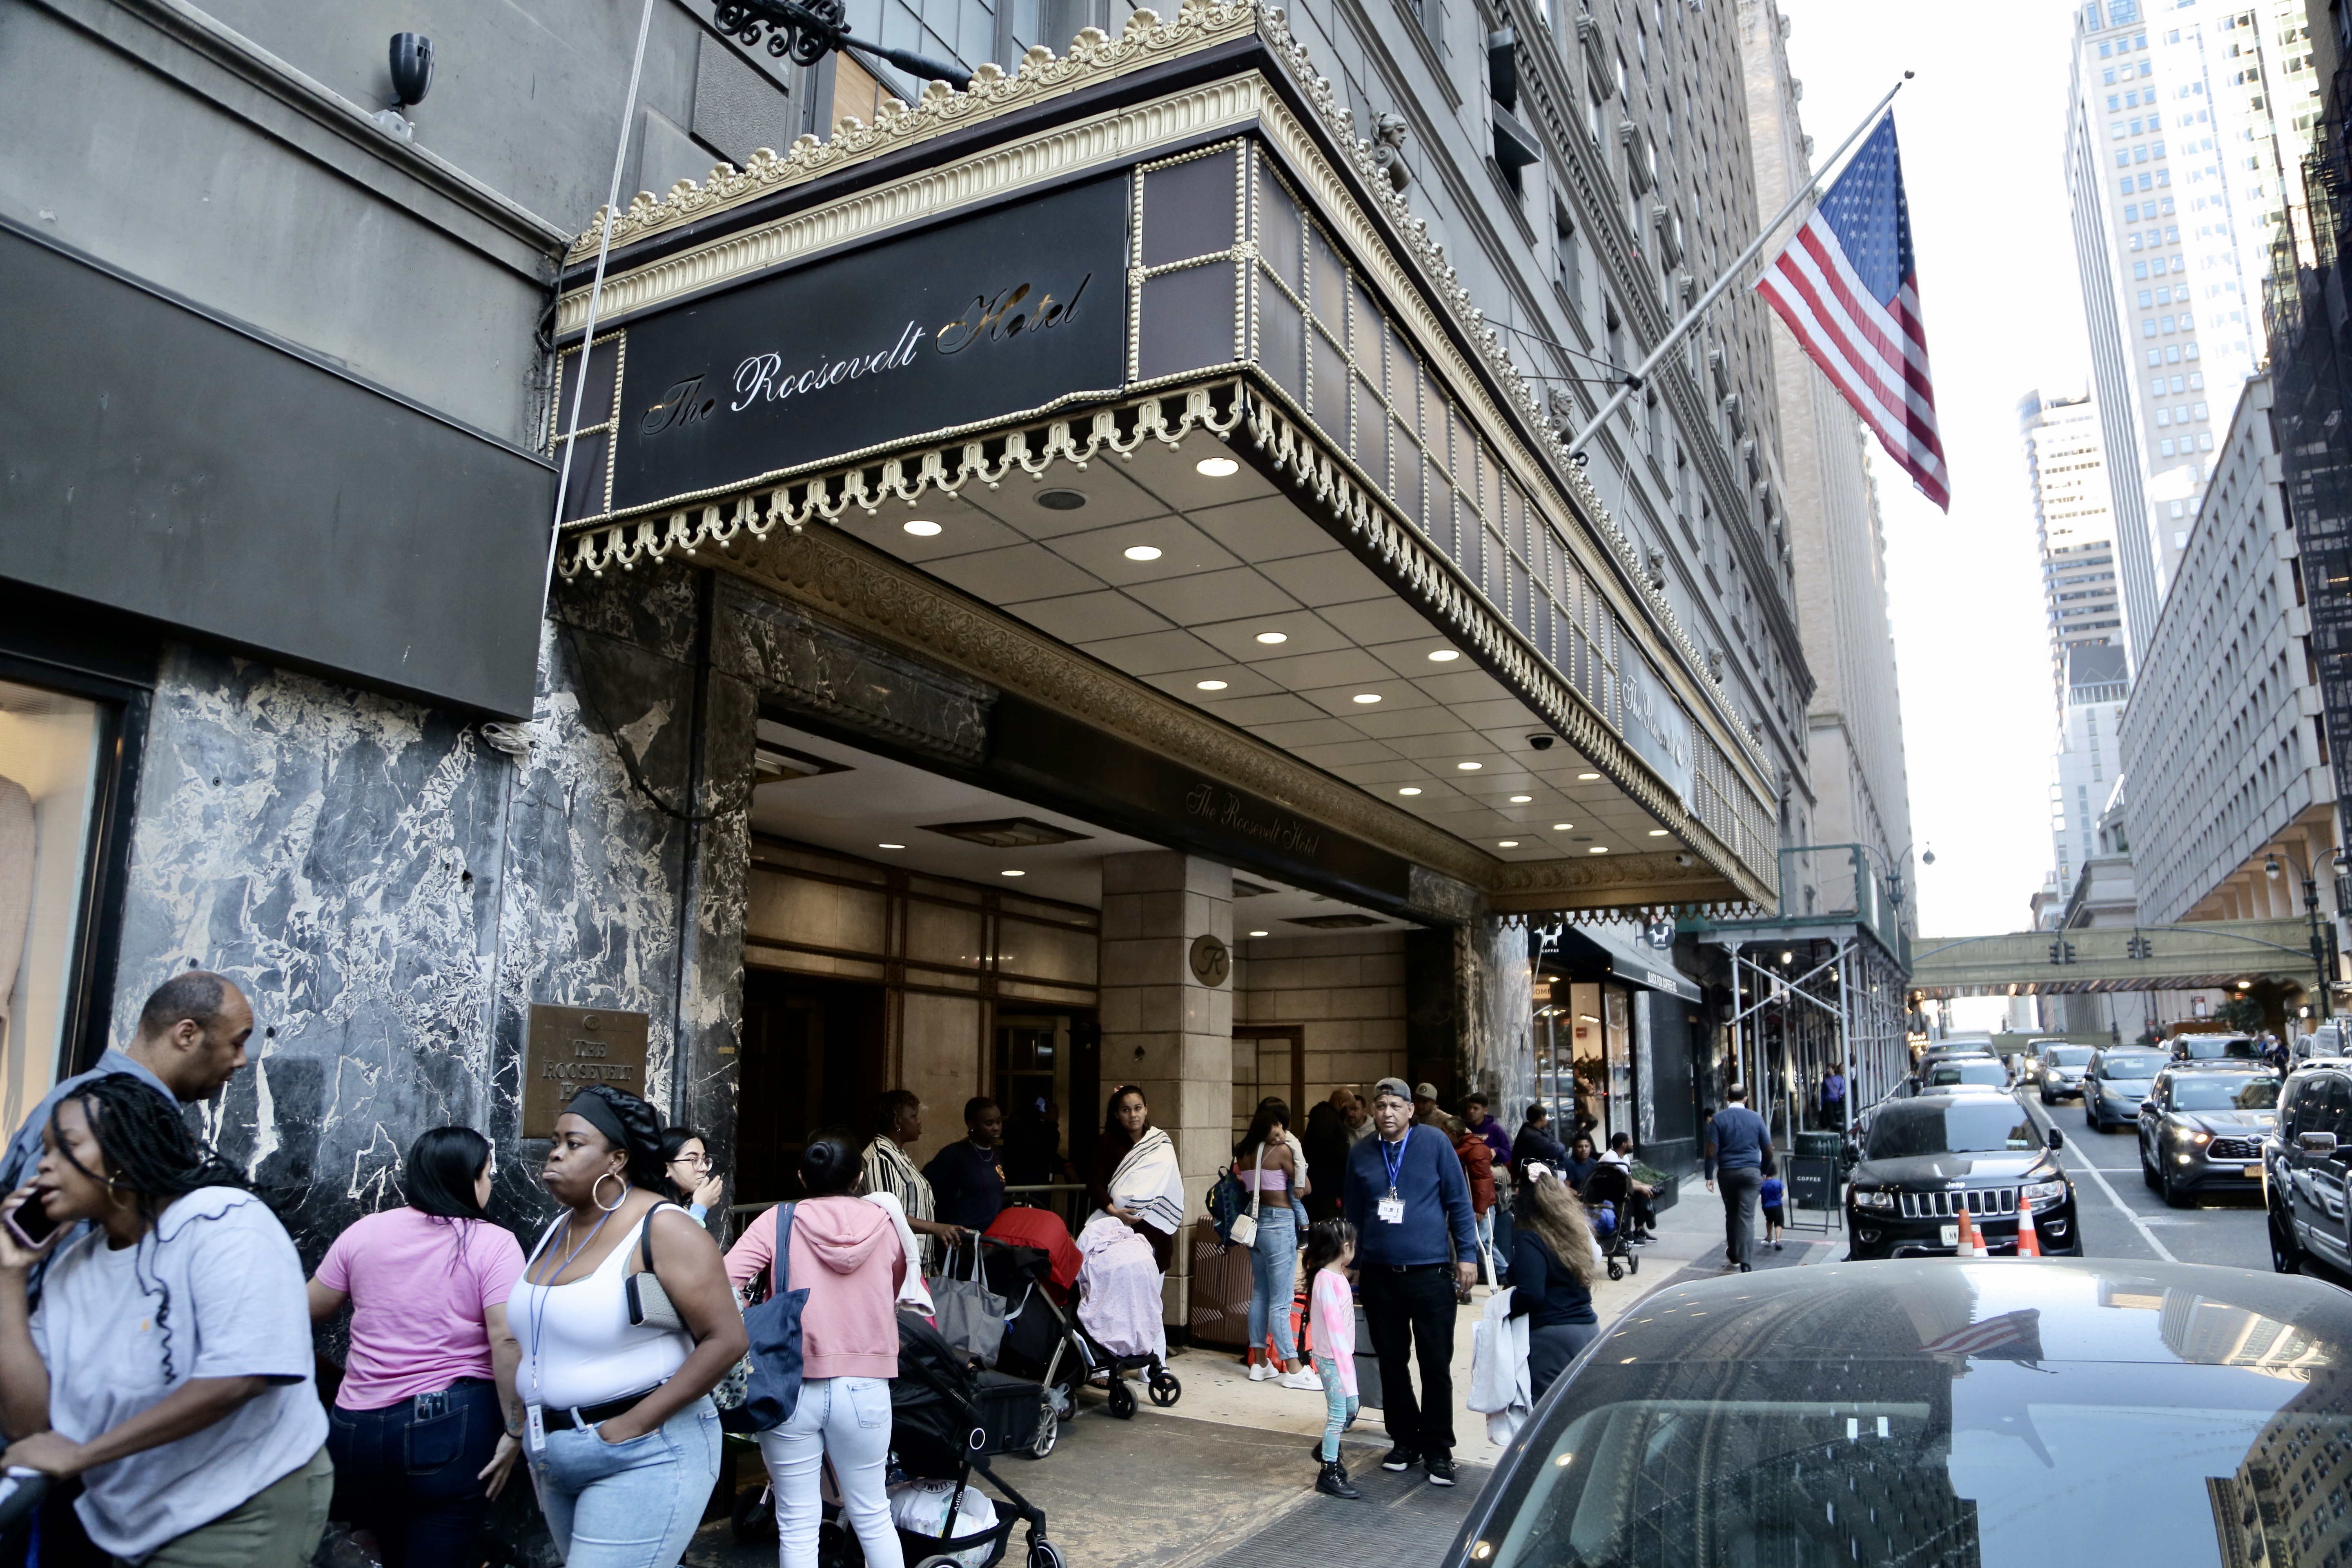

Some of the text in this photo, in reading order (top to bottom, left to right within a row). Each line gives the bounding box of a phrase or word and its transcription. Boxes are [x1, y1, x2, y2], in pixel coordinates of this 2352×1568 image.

[641, 272, 1092, 435] The Roosevelt Hotel
[1623, 674, 1642, 722] The
[1186, 783, 1319, 858] The Roosevelt Hotel
[574, 1040, 606, 1057] THE
[542, 1061, 633, 1080] ROOSEVELT
[954, 1491, 963, 1512] Arlifo
